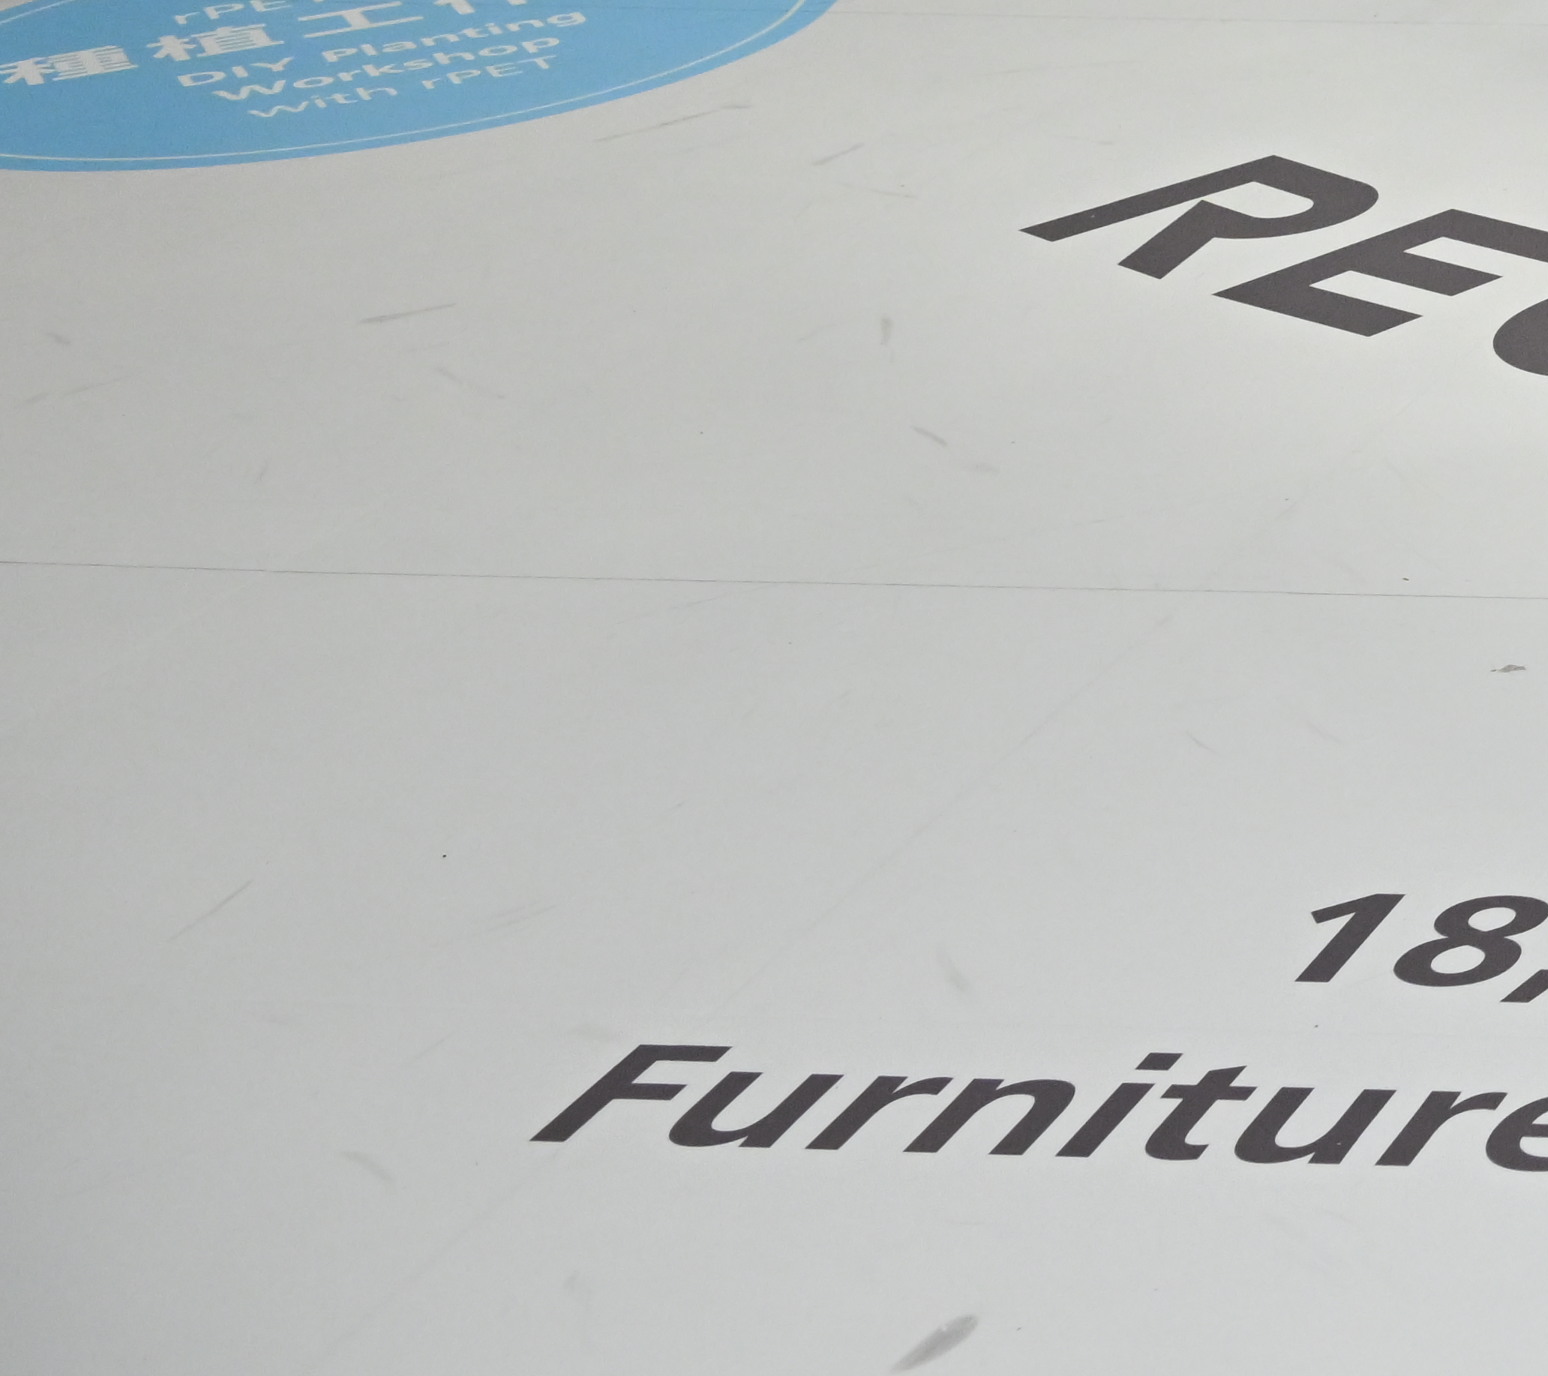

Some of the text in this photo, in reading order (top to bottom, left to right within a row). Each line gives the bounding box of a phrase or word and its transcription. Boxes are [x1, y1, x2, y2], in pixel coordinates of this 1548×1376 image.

[176, 11, 588, 88] DIY Planting
[211, 36, 562, 103] Workshop
[248, 54, 560, 119] with rPET
